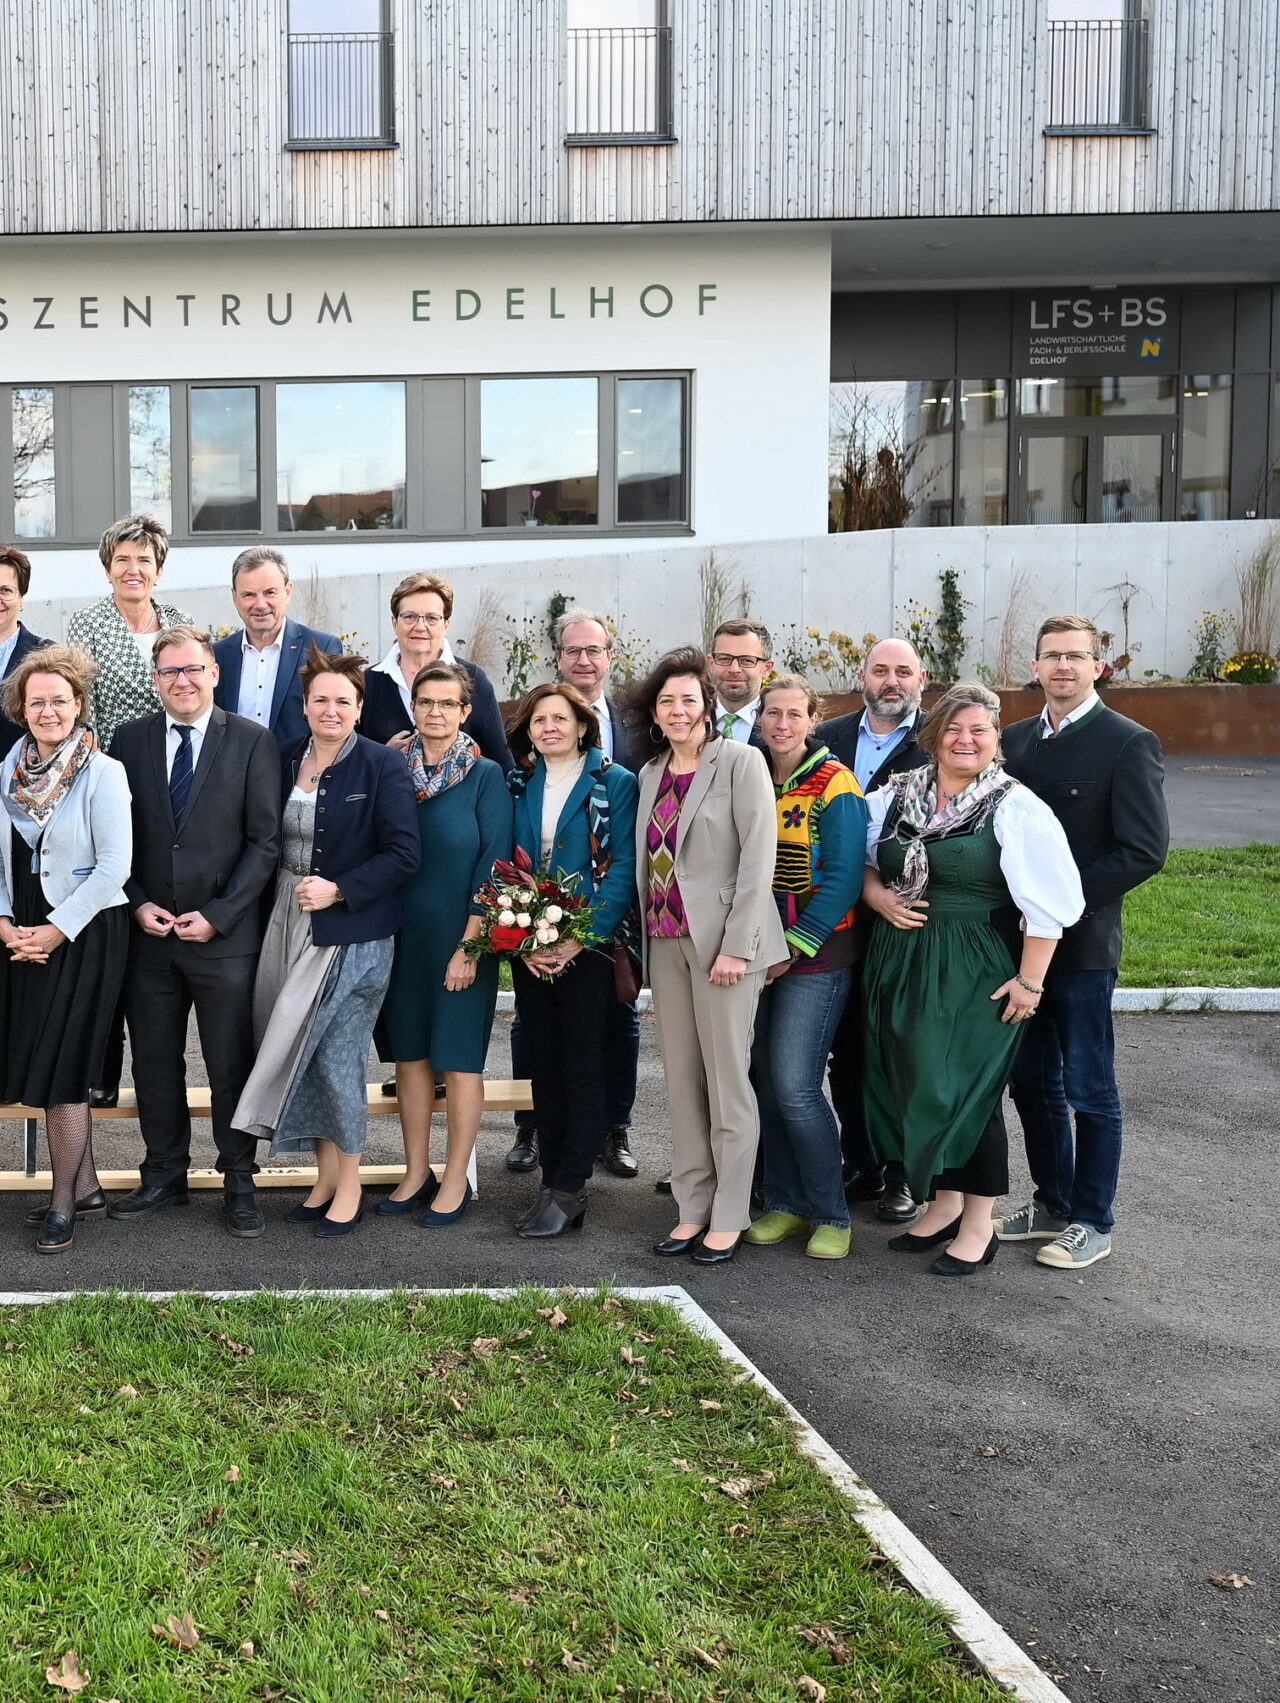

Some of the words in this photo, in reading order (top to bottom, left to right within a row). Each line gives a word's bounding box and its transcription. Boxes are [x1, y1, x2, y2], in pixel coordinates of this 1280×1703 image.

[412, 284, 717, 322] EDELHOF
[1030, 297, 1167, 330] LFS+BS
[1029, 335, 1127, 345] LANDWIRTSCHAFTLICHE
[1064, 345, 1126, 354] BERUFSSCHULE
[1029, 356, 1068, 365] EDELHOF
